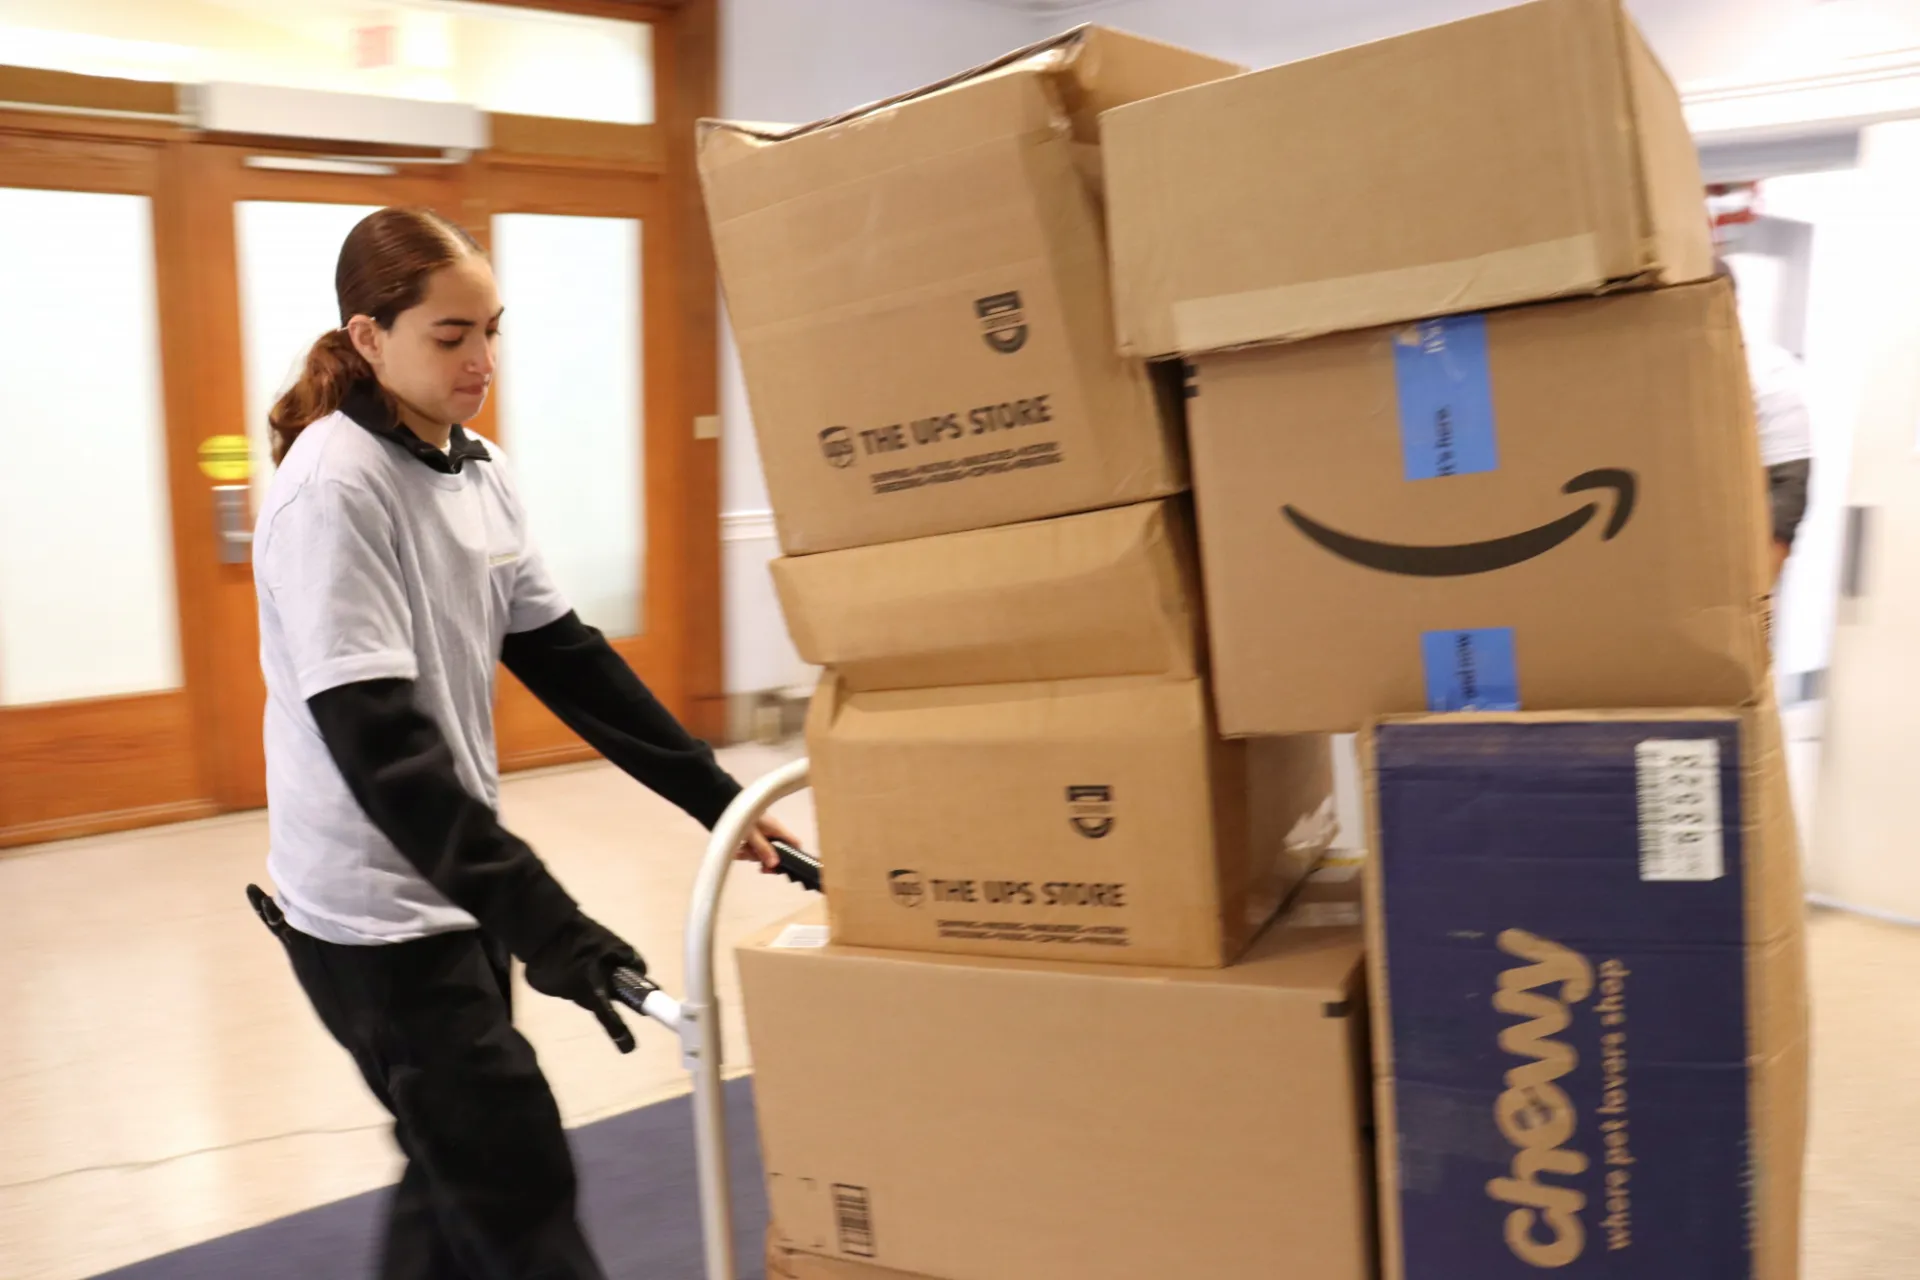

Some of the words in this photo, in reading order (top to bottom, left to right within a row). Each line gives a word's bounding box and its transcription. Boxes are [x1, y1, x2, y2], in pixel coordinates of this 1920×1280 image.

[857, 424, 908, 455] THE
[910, 412, 963, 446] UPS
[968, 394, 1053, 435] STORE
[929, 878, 979, 903] THE
[981, 879, 1037, 905] UPS
[1040, 881, 1129, 908] STORE
[1592, 958, 1632, 1026] shop
[1485, 928, 1596, 1269] chewy
[1594, 1030, 1629, 1115] lovers
[1598, 1118, 1638, 1165] pet
[1598, 1168, 1633, 1251] where
